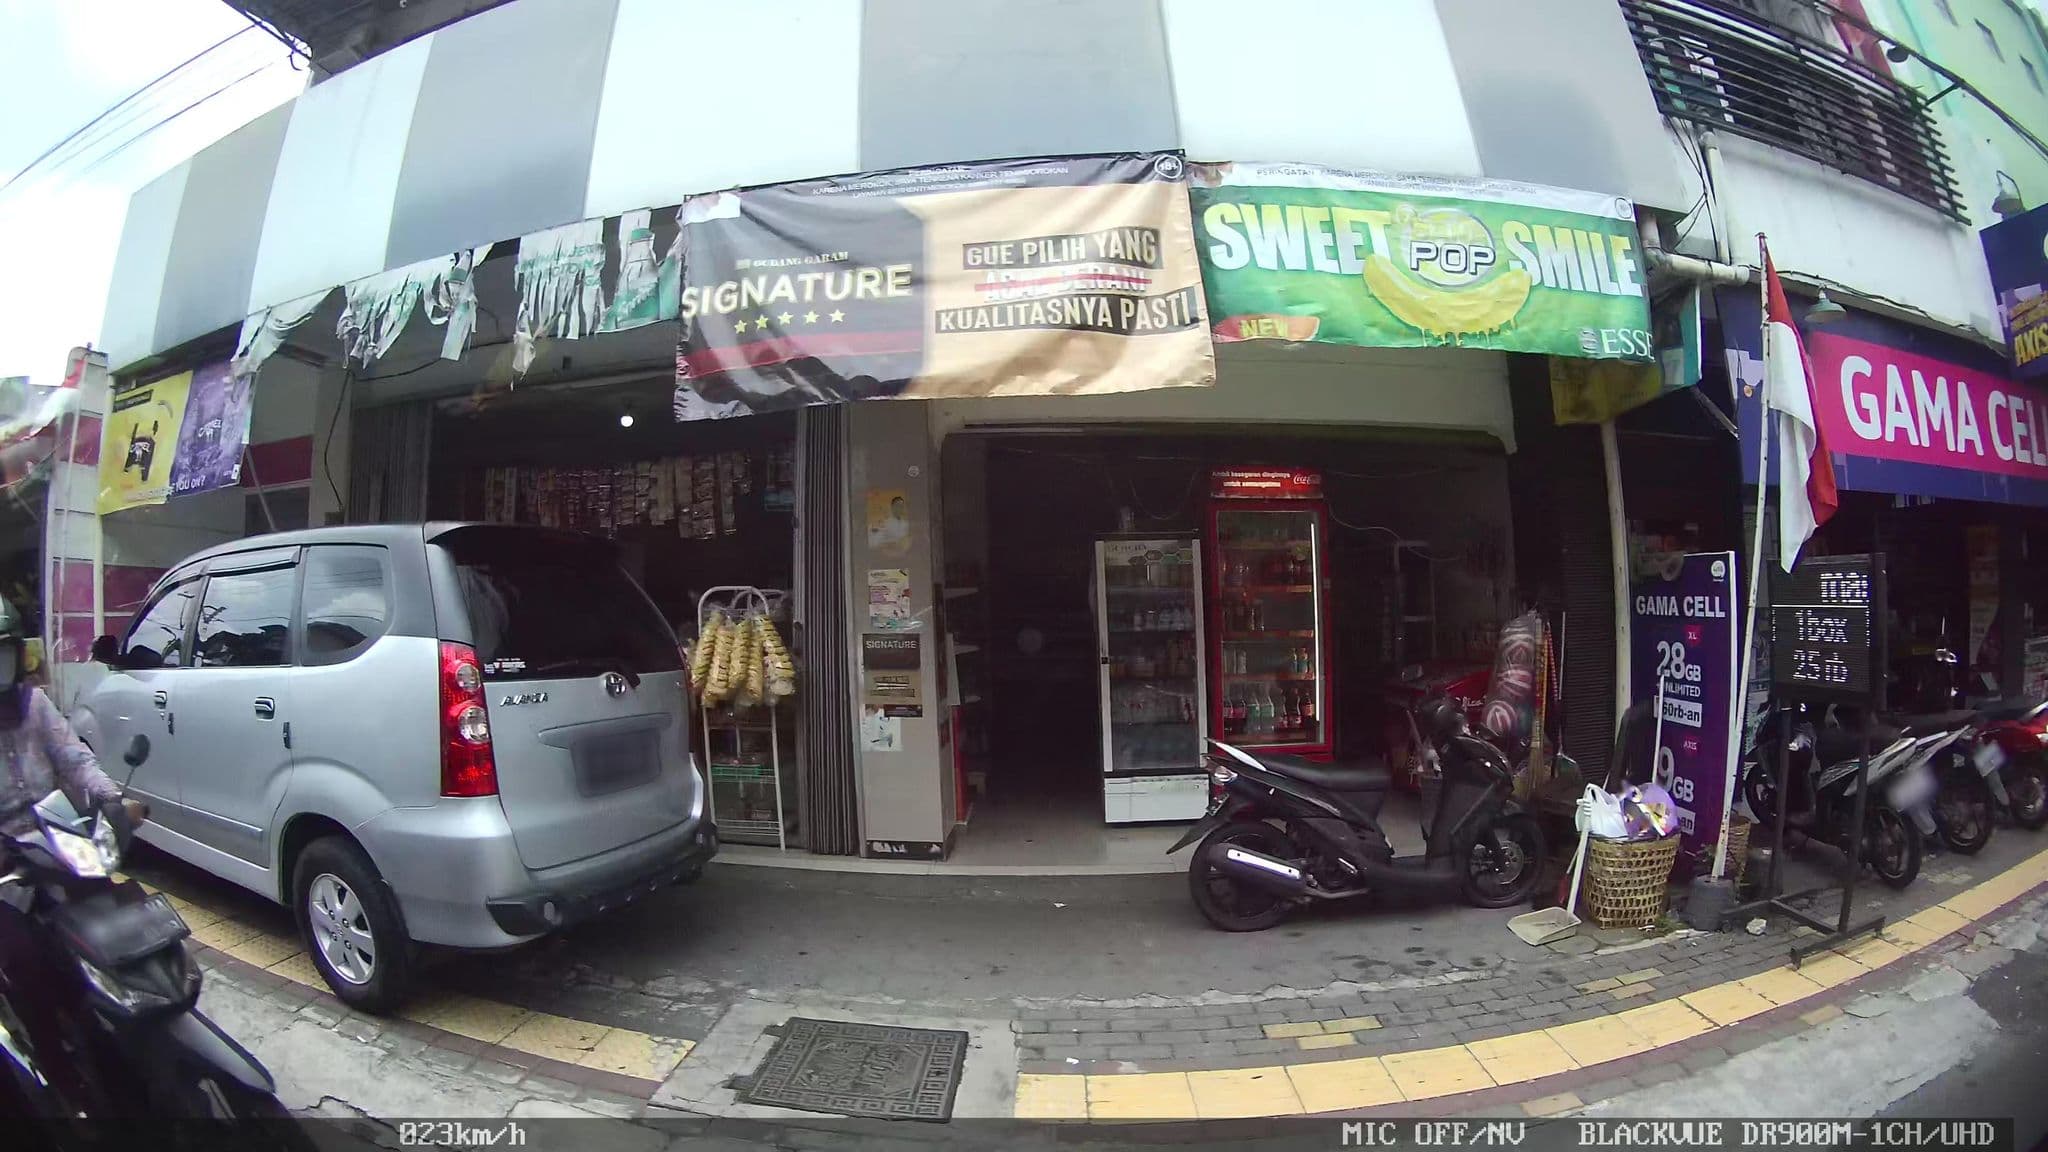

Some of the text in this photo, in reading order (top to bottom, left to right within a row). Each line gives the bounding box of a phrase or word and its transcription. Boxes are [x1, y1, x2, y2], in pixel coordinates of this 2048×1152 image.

[967, 230, 1157, 266] GUE PILIH YANG
[1203, 204, 1643, 297] SWEET SMILE
[1409, 240, 1496, 276] POP
[682, 263, 913, 319] SIGNATURE
[940, 297, 1114, 331] KUALITASNYA
[1841, 355, 1985, 457] GAMA
[1636, 595, 1726, 618] GAMA CELL
[1660, 681, 1701, 698] NLIMITED
